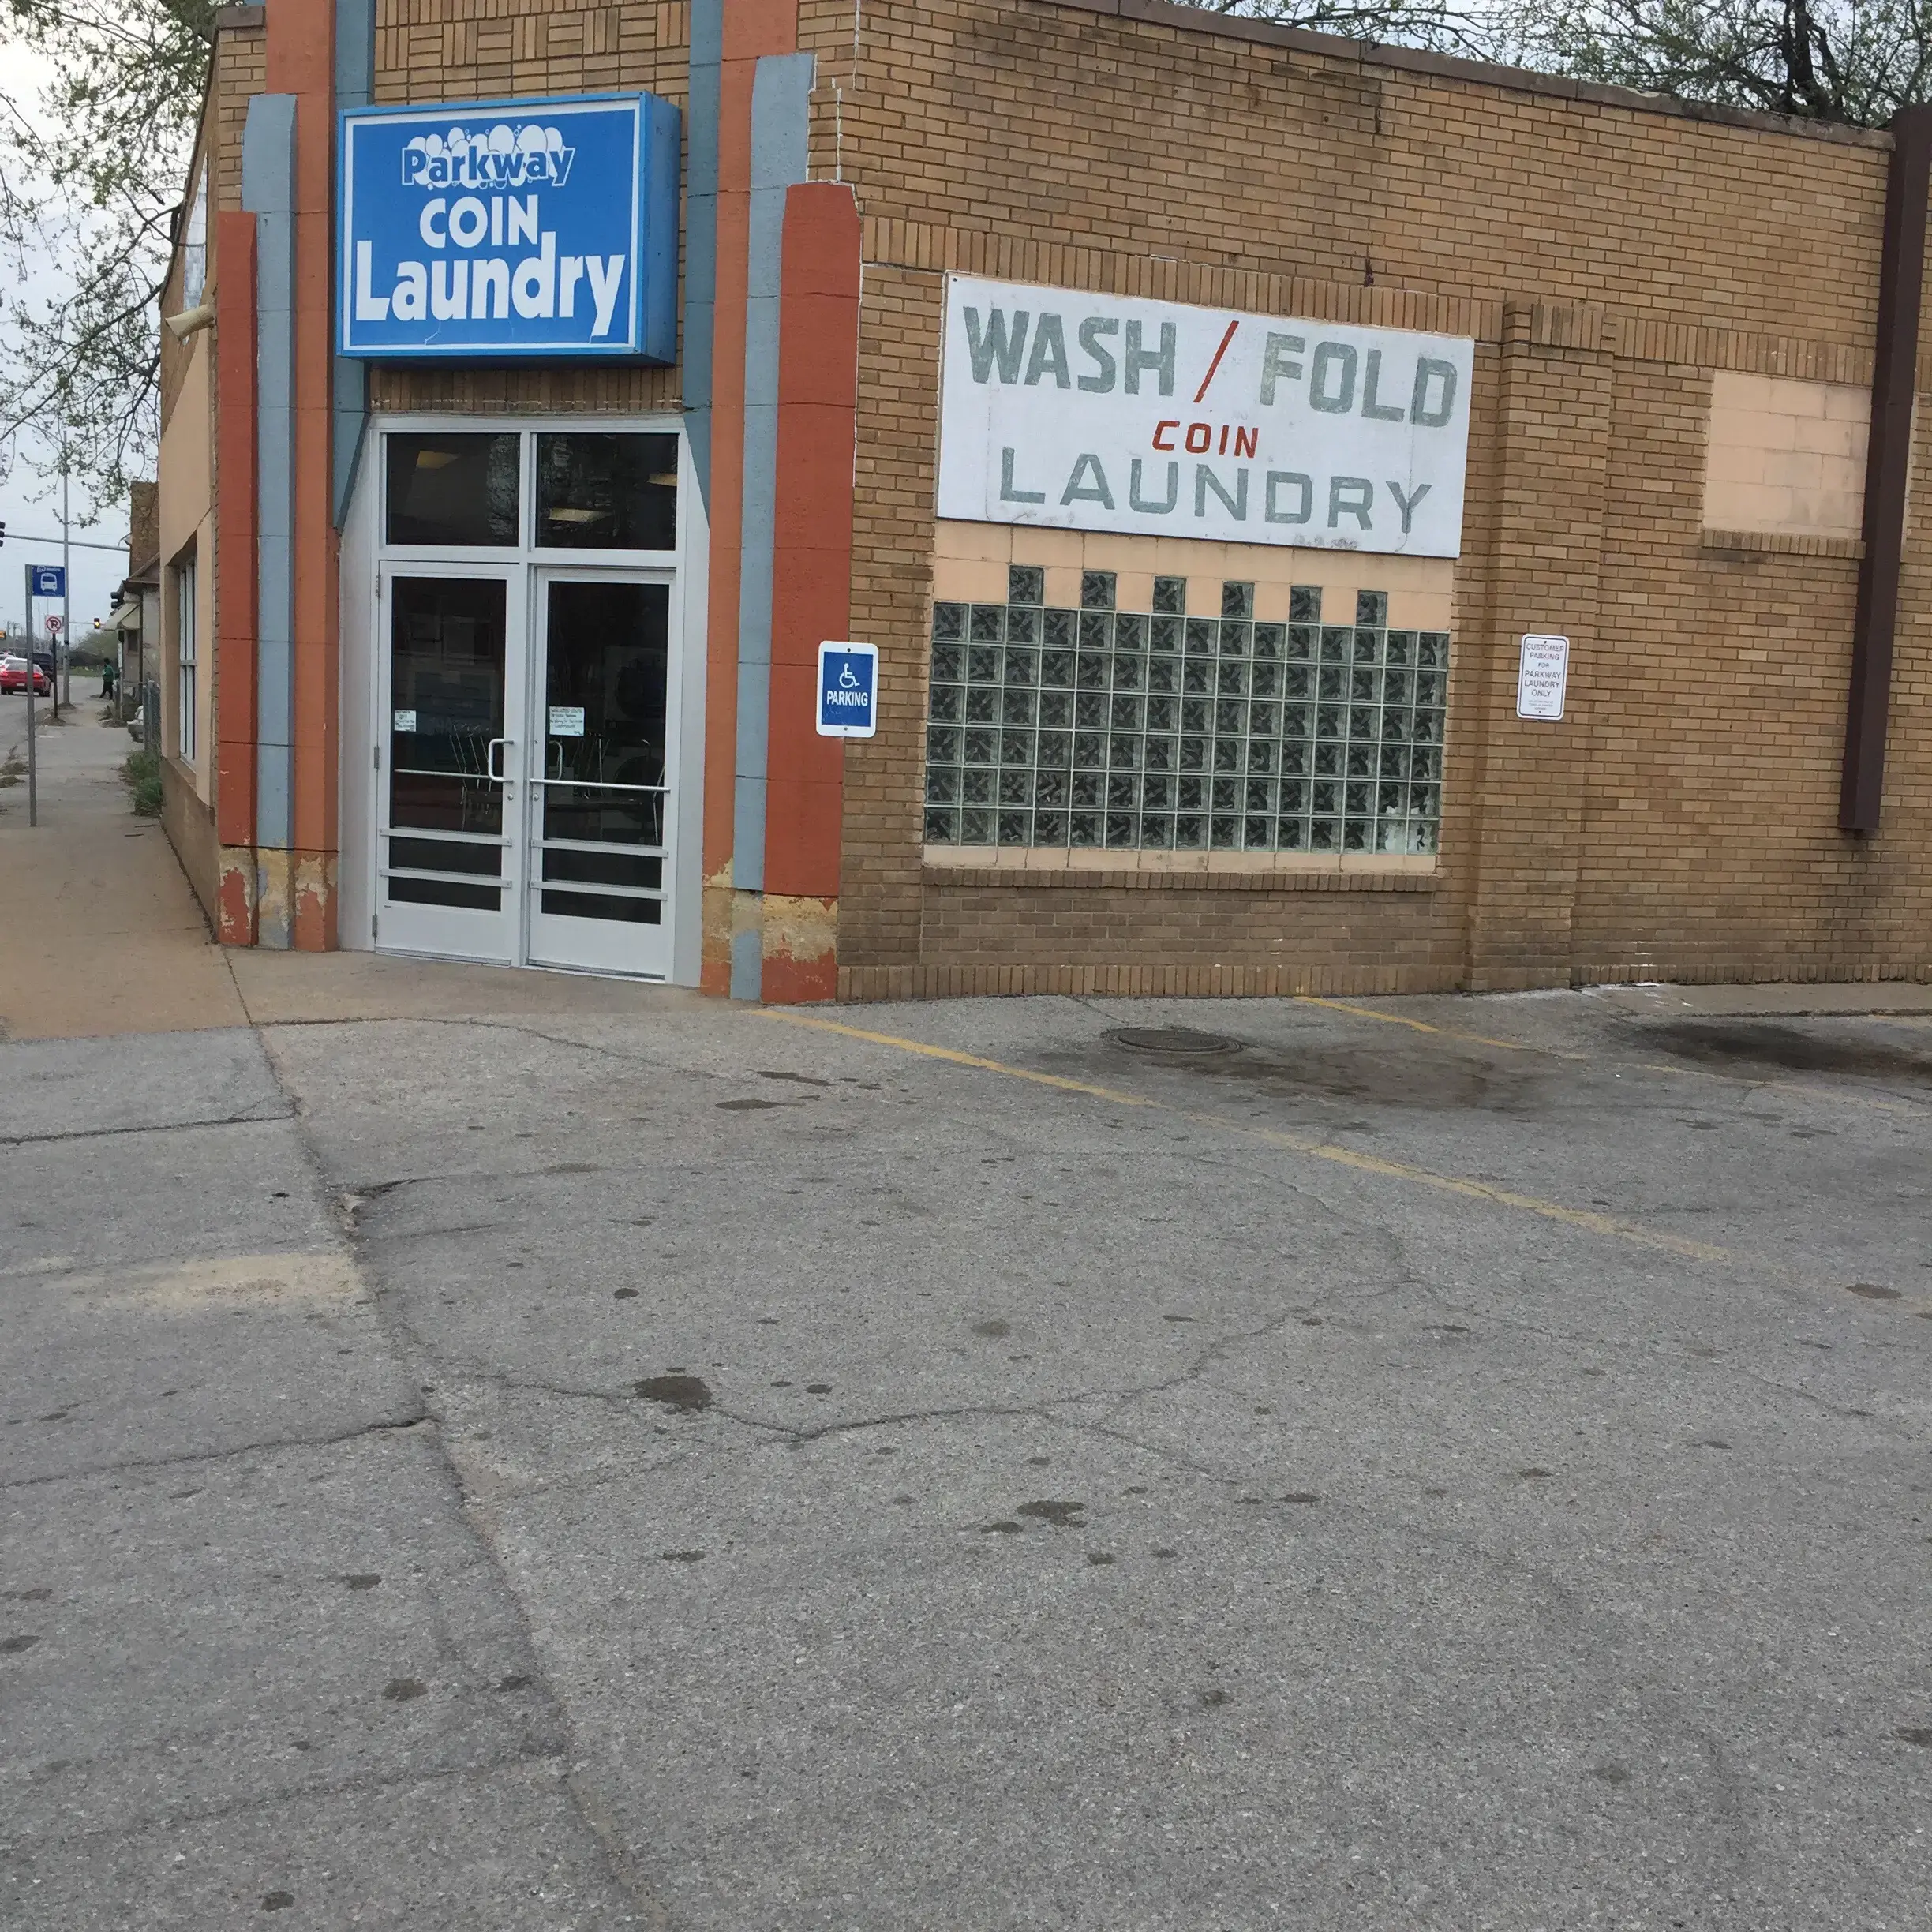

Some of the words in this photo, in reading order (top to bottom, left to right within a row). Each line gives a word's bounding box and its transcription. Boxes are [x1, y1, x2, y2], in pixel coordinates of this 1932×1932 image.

[402, 144, 575, 187] Parkway
[420, 194, 538, 249] COIN
[355, 231, 625, 336] Laundry
[963, 305, 1177, 396] WASH
[1260, 331, 1458, 427] FOLD
[1151, 420, 1259, 459] COIN
[999, 447, 1432, 534] LAUNDRY
[1526, 643, 1564, 652] CUSTOMER
[1525, 670, 1561, 679] PARKWAY
[1525, 680, 1559, 688] LAUNDRY
[826, 691, 868, 706] PARKING
